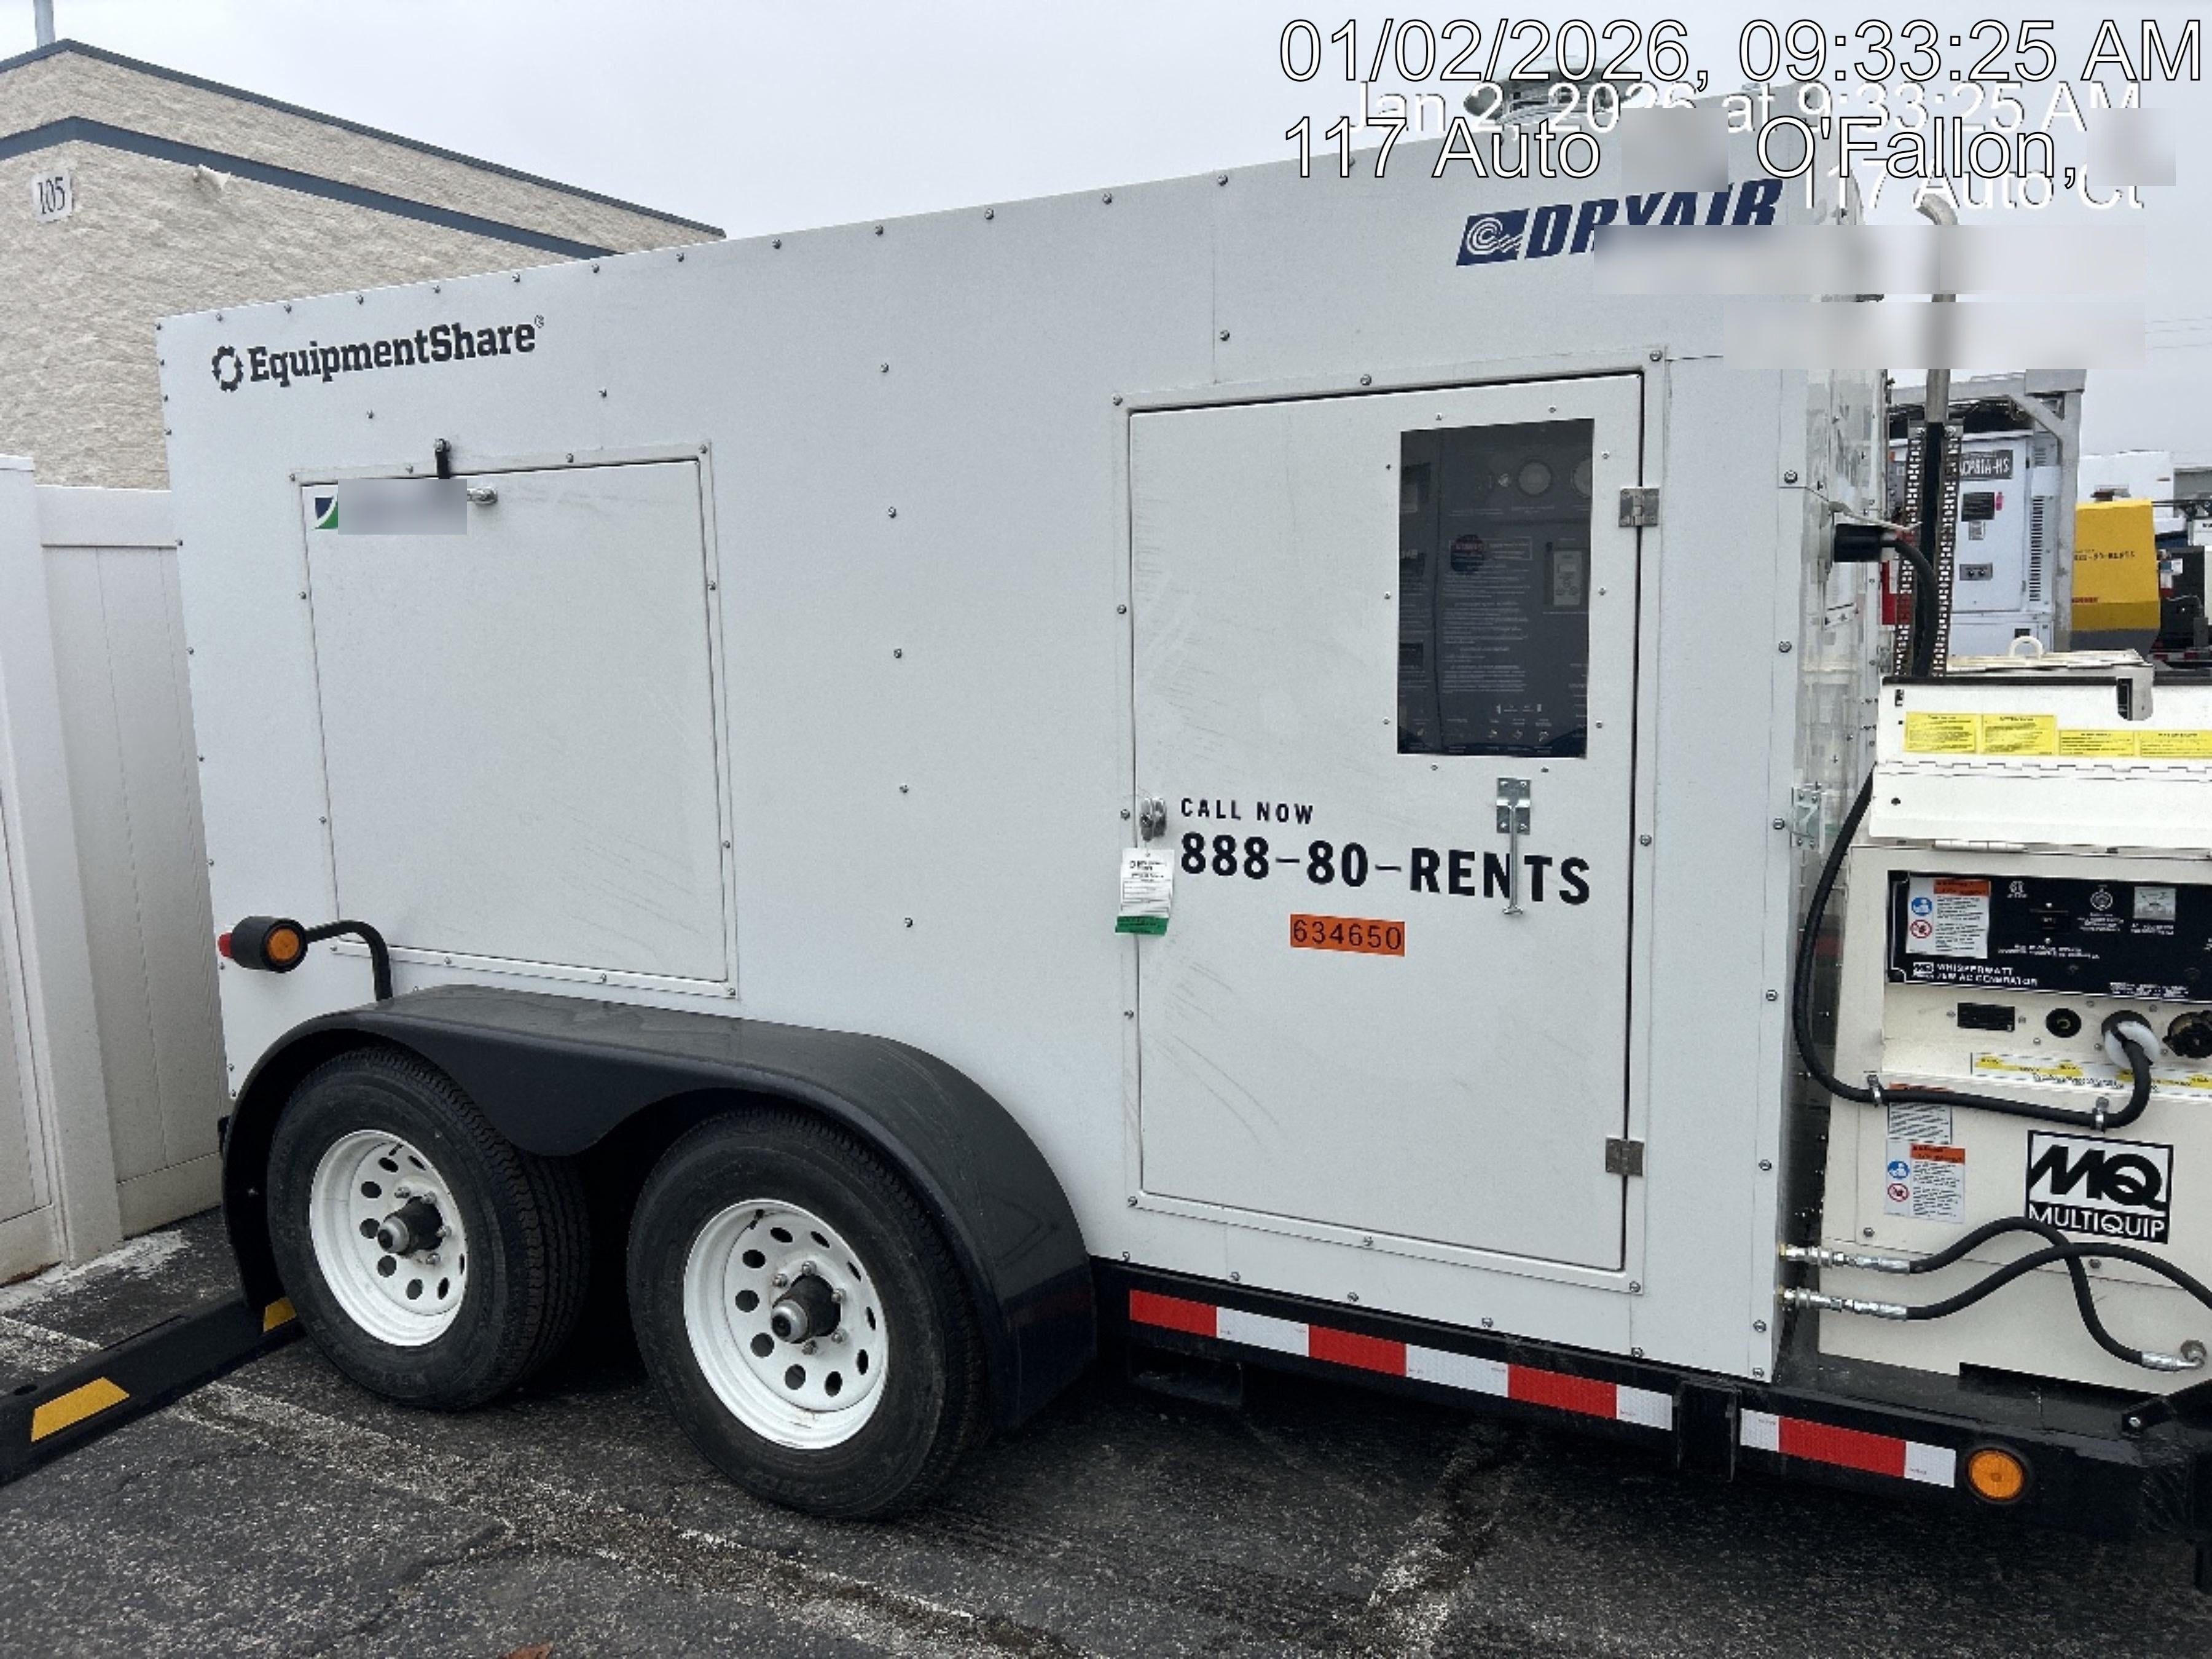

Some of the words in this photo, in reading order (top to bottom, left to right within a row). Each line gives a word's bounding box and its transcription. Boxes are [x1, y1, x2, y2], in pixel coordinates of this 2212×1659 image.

[37, 176, 66, 214] 105
[249, 322, 536, 387] EquipmentShare
[1180, 798, 1242, 821] CALL
[1256, 801, 1314, 825] NOW
[1180, 831, 1591, 906] 888-80-RENTS
[1292, 919, 1403, 951] 634650
[2028, 1144, 2169, 1213] MQ
[2028, 1202, 2165, 1239] MULTIQUIP
